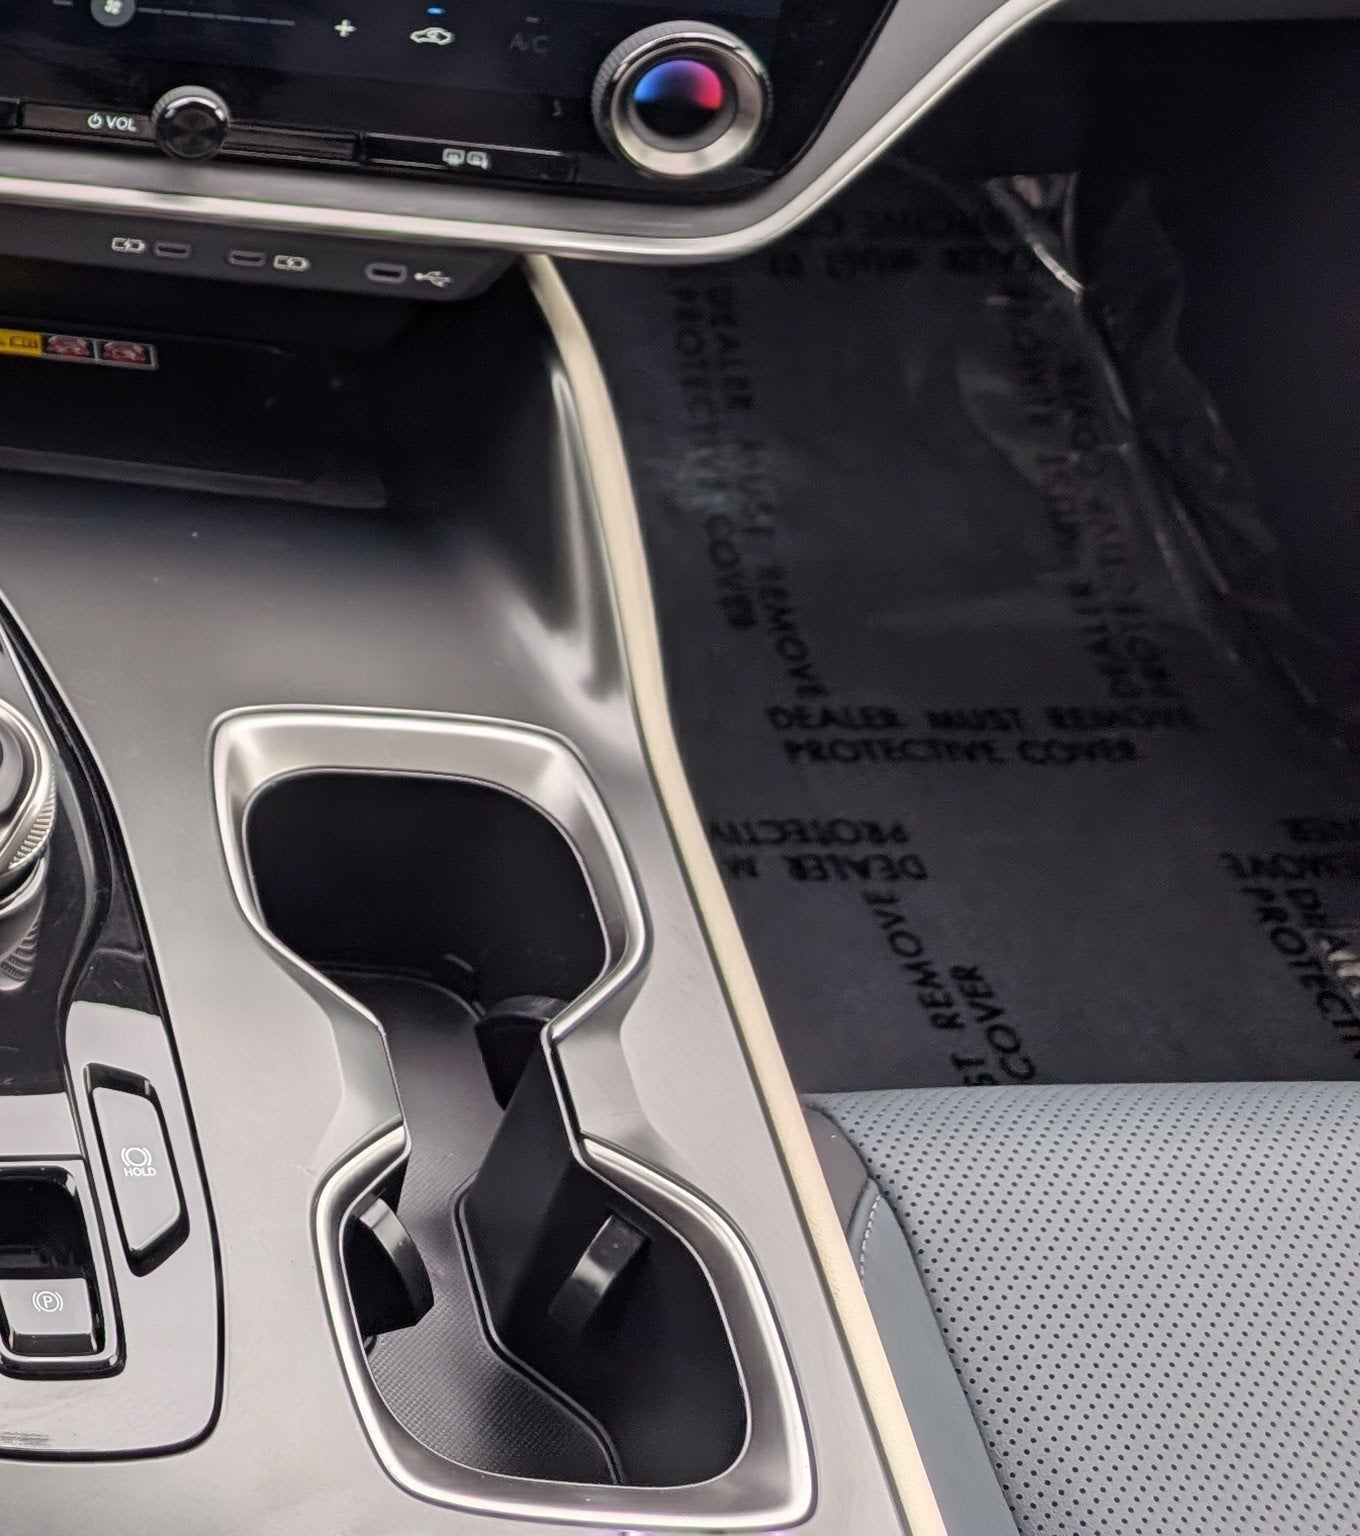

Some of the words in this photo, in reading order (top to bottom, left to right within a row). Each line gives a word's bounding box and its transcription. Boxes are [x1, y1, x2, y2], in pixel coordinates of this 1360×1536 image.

[510, 33, 550, 55] A/C
[106, 113, 138, 133] VOL
[765, 705, 906, 731] DEALER
[784, 737, 1005, 765] PROTECTIVE
[1016, 737, 1139, 766] COVER
[787, 852, 929, 883] DEALER
[861, 886, 967, 1034] REMOVE
[948, 964, 1037, 1083] COVER
[123, 1166, 157, 1178] HOLD
